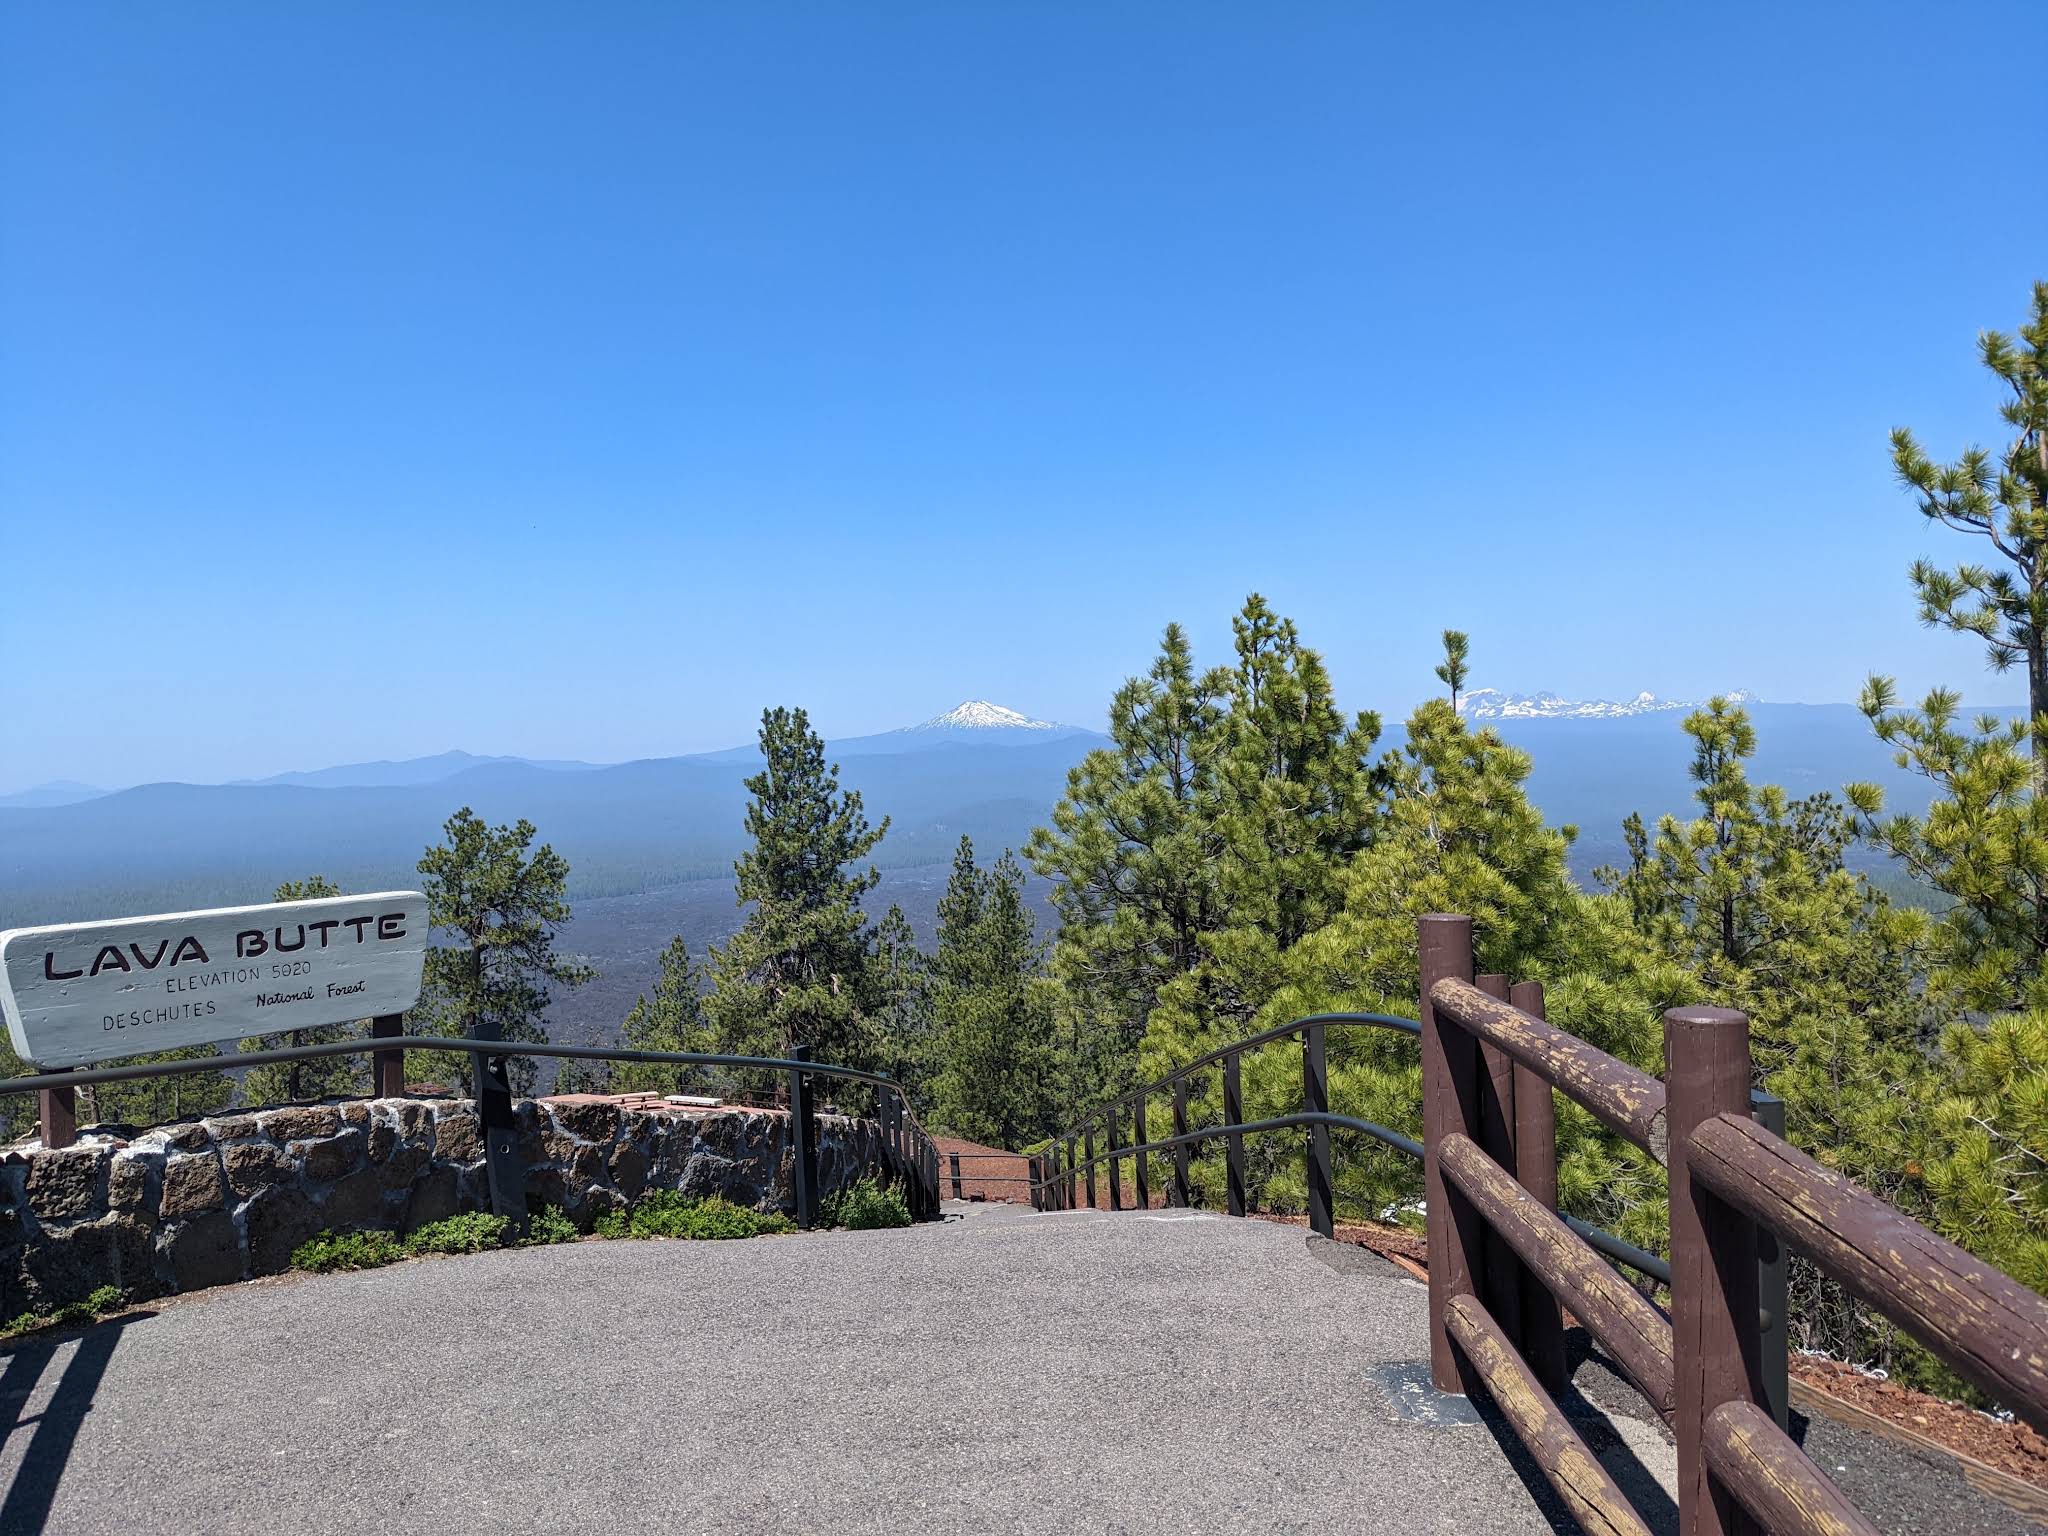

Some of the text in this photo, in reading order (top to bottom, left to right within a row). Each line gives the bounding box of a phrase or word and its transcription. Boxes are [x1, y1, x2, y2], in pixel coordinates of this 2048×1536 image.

[45, 913, 407, 981] LAVA BUTTE
[166, 961, 311, 993] ELEVATION 5020
[103, 980, 366, 1032] DESCHUTES National Forest
